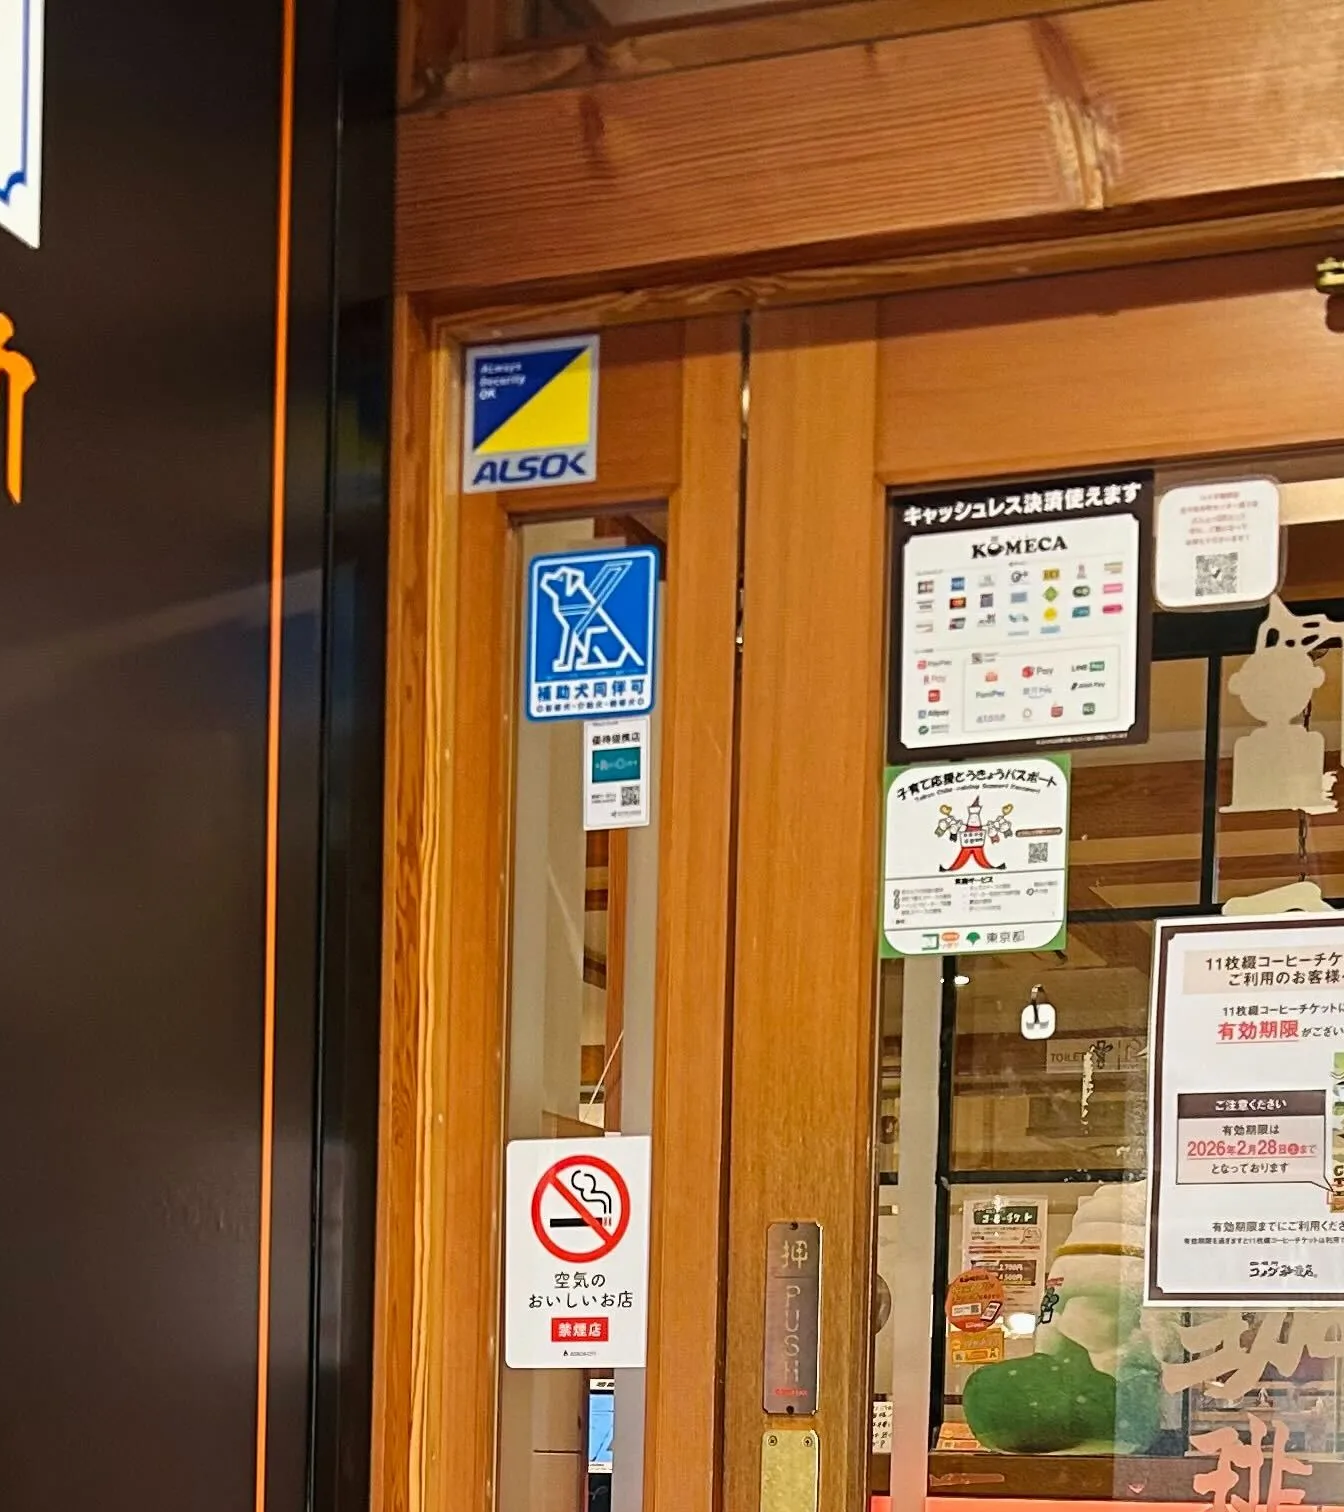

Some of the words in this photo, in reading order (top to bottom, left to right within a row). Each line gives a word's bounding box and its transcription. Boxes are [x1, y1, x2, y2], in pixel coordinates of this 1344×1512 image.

[472, 451, 587, 486] ALSOK
[903, 482, 1142, 527] キャッシュレス決済使えます
[538, 678, 646, 703] 補助犬同伴可
[985, 930, 1025, 944] 東京都
[1221, 1124, 1280, 1137] 有効期限は
[1211, 1161, 1289, 1175] となっております
[781, 1239, 809, 1270] 押
[554, 1271, 606, 1290] 空気の
[528, 1291, 634, 1310] おいしいお店
[557, 1321, 603, 1339] 禁煙店
[783, 1285, 801, 1383] PUSH
